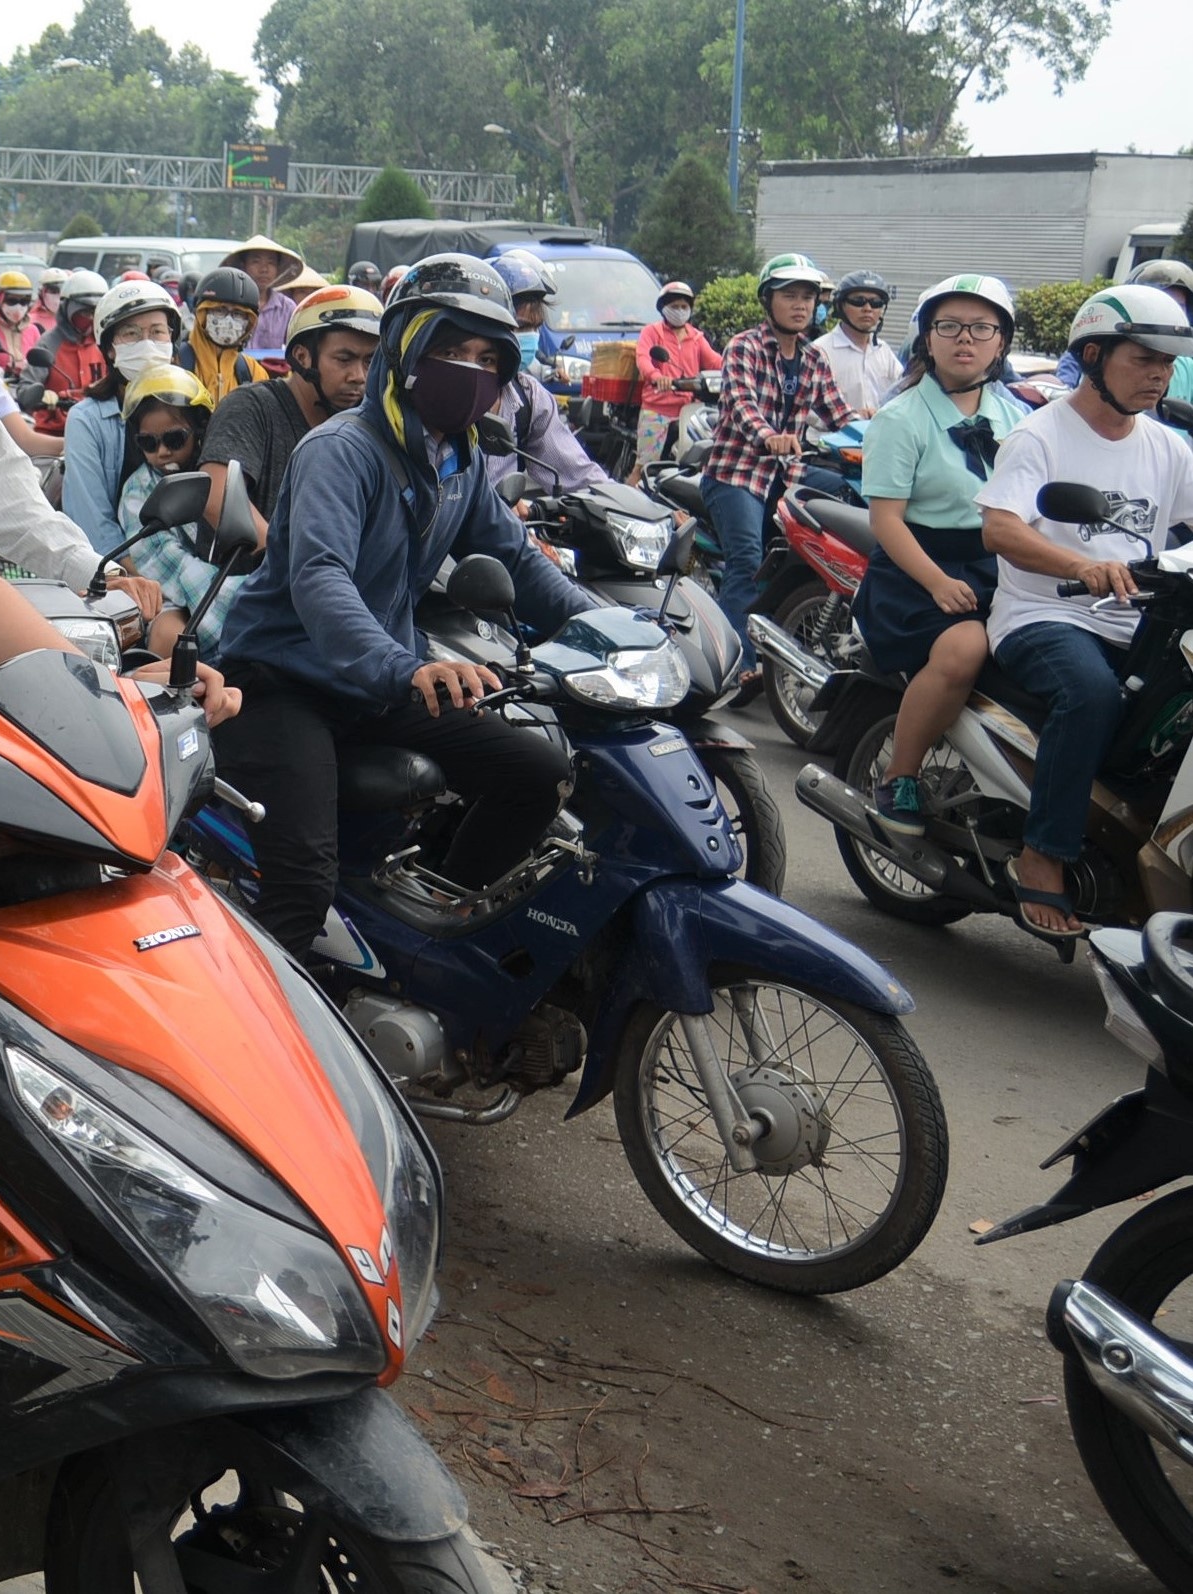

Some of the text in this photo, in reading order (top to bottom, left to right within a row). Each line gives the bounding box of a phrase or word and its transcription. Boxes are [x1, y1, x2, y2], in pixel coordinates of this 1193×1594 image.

[461, 268, 505, 292] HONDA
[527, 908, 580, 937] HONDA
[135, 924, 201, 951] HONDA
